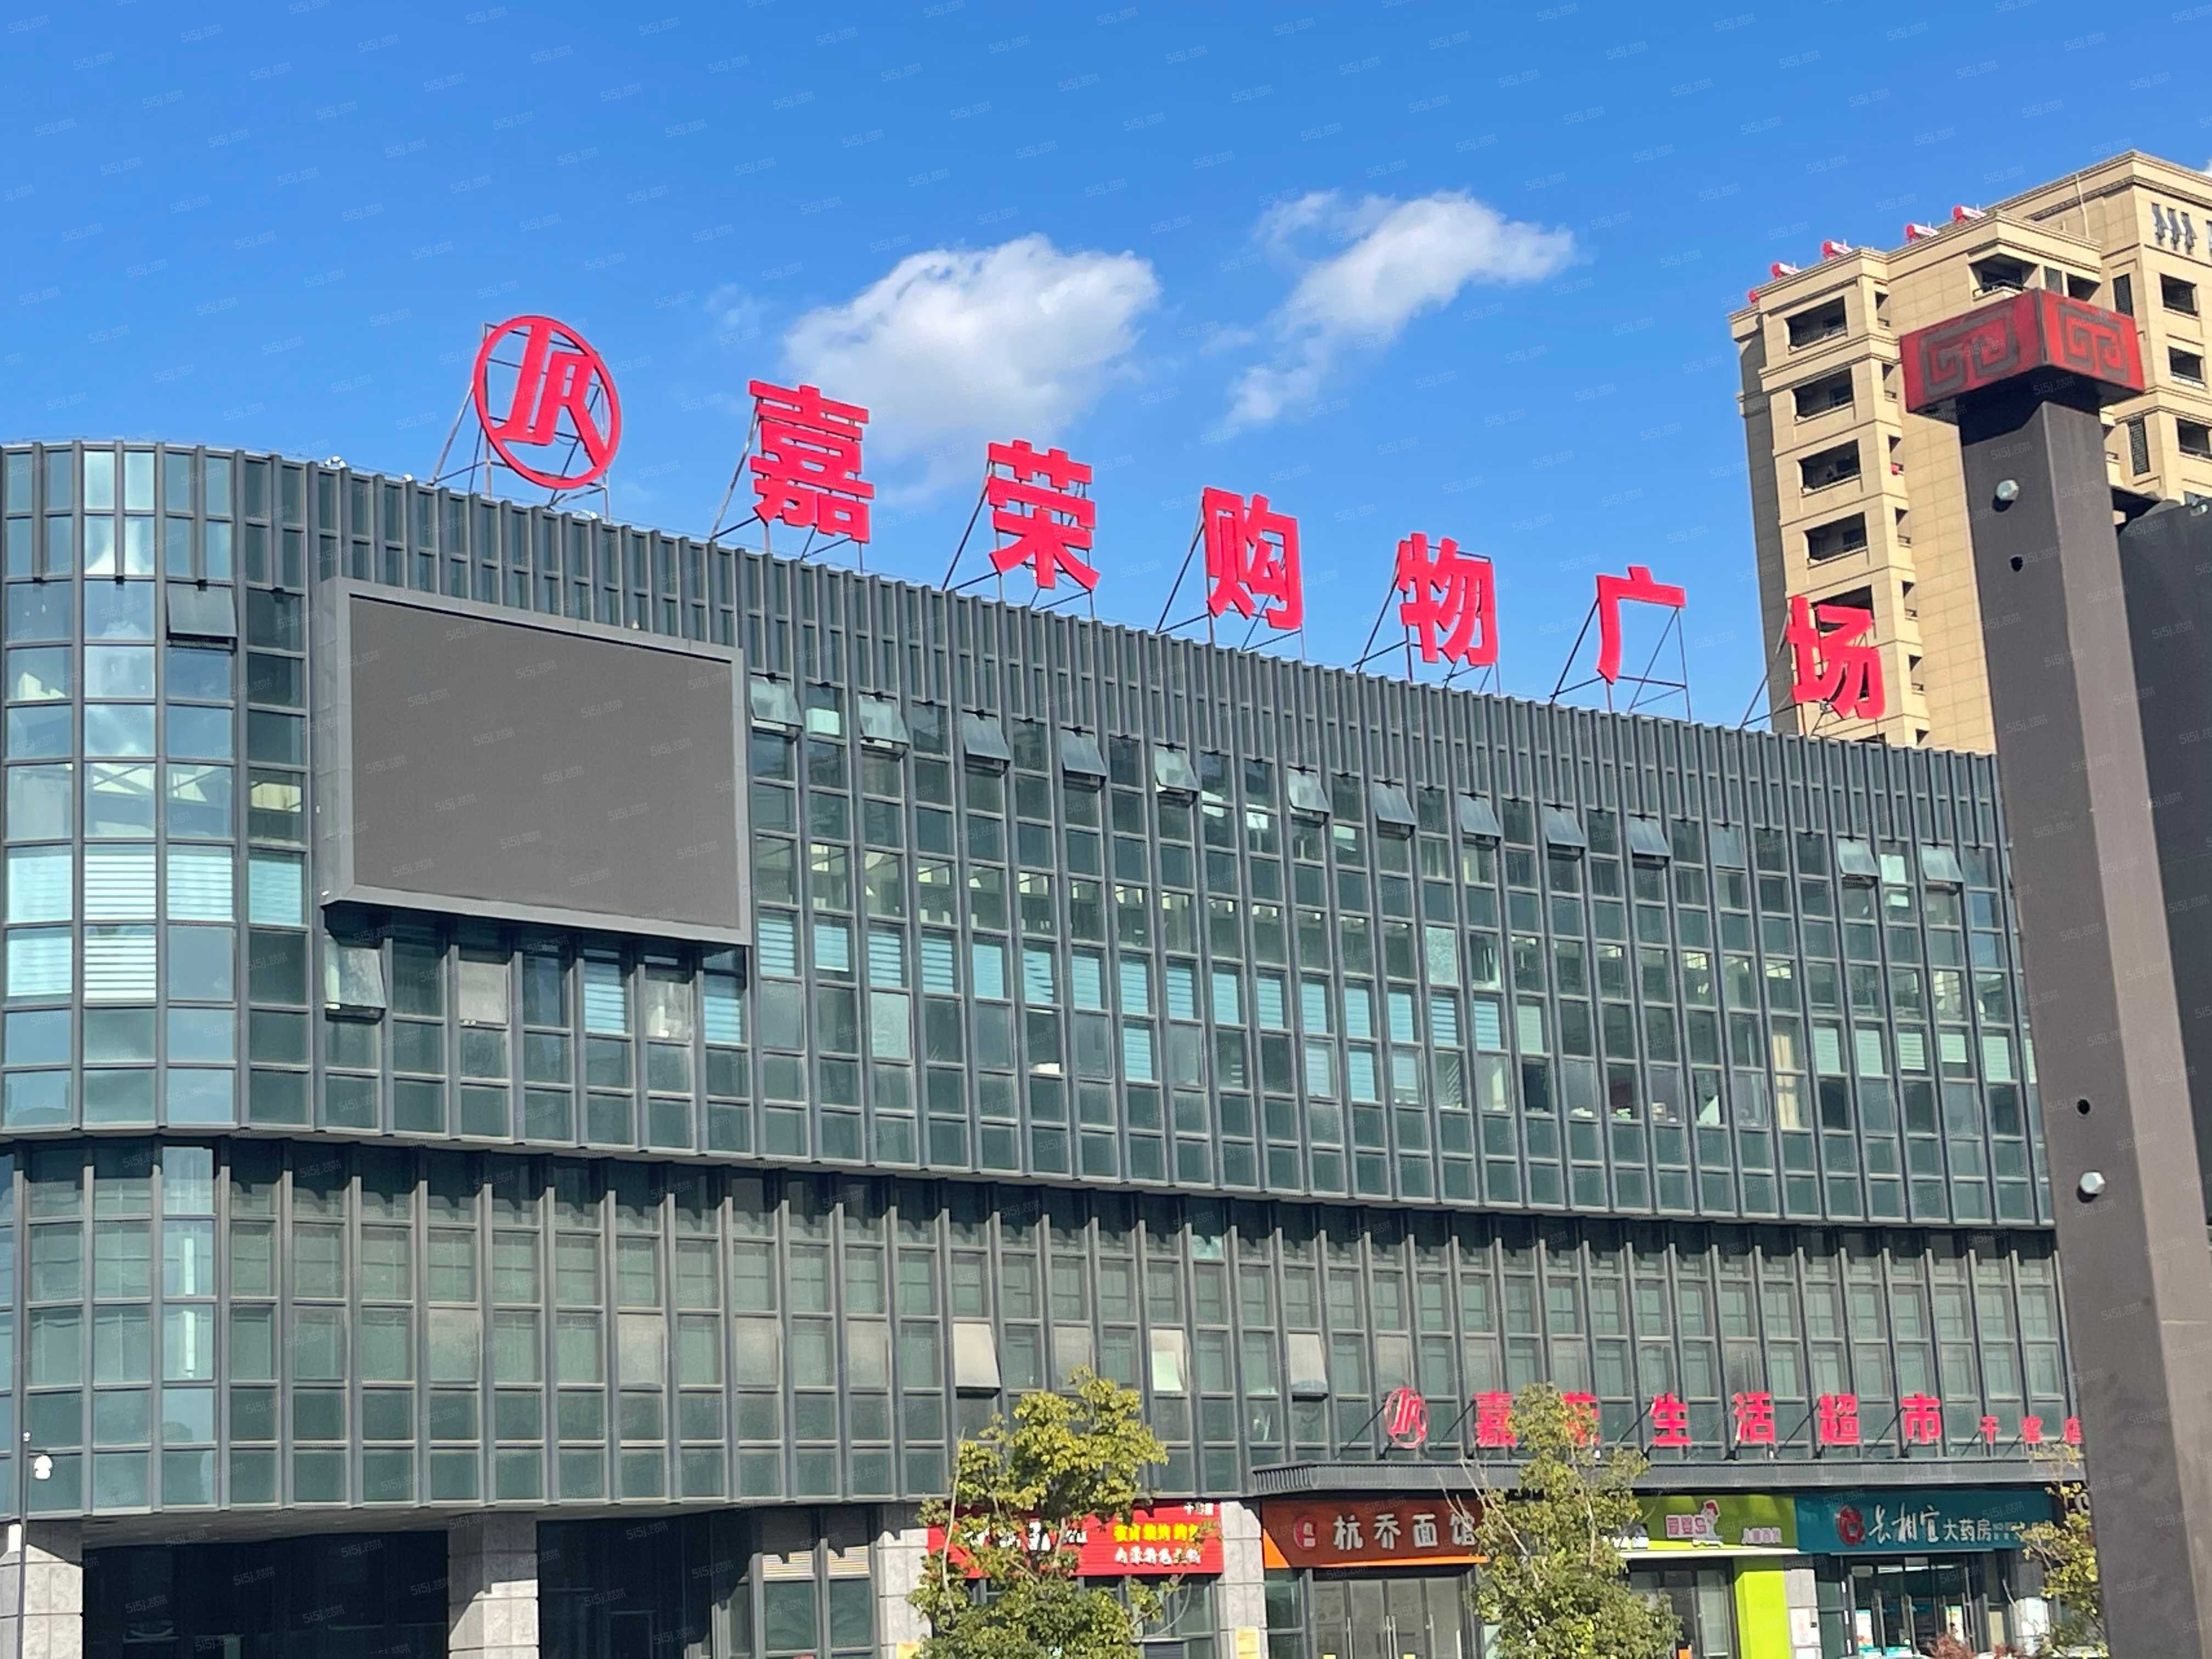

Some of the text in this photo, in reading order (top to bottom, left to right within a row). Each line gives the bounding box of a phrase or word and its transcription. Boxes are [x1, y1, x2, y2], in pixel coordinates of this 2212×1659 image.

[748, 380, 1886, 720] 嘉荣购物广场
